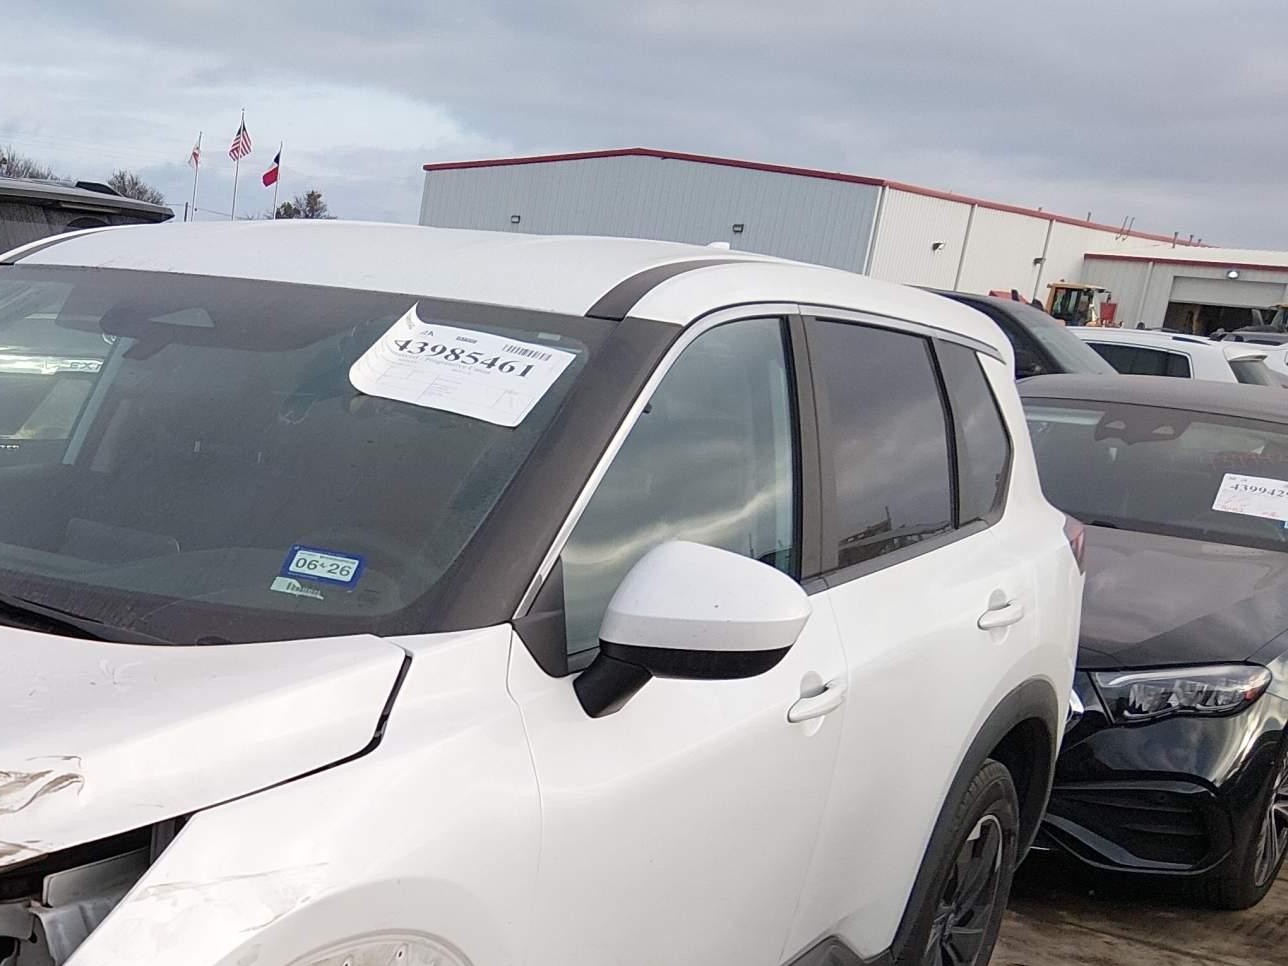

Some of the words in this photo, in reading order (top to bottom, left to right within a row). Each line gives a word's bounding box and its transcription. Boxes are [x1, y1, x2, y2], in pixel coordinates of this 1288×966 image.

[394, 339, 536, 377] 43985461
[295, 557, 319, 570] 06
[327, 562, 353, 576] 26
